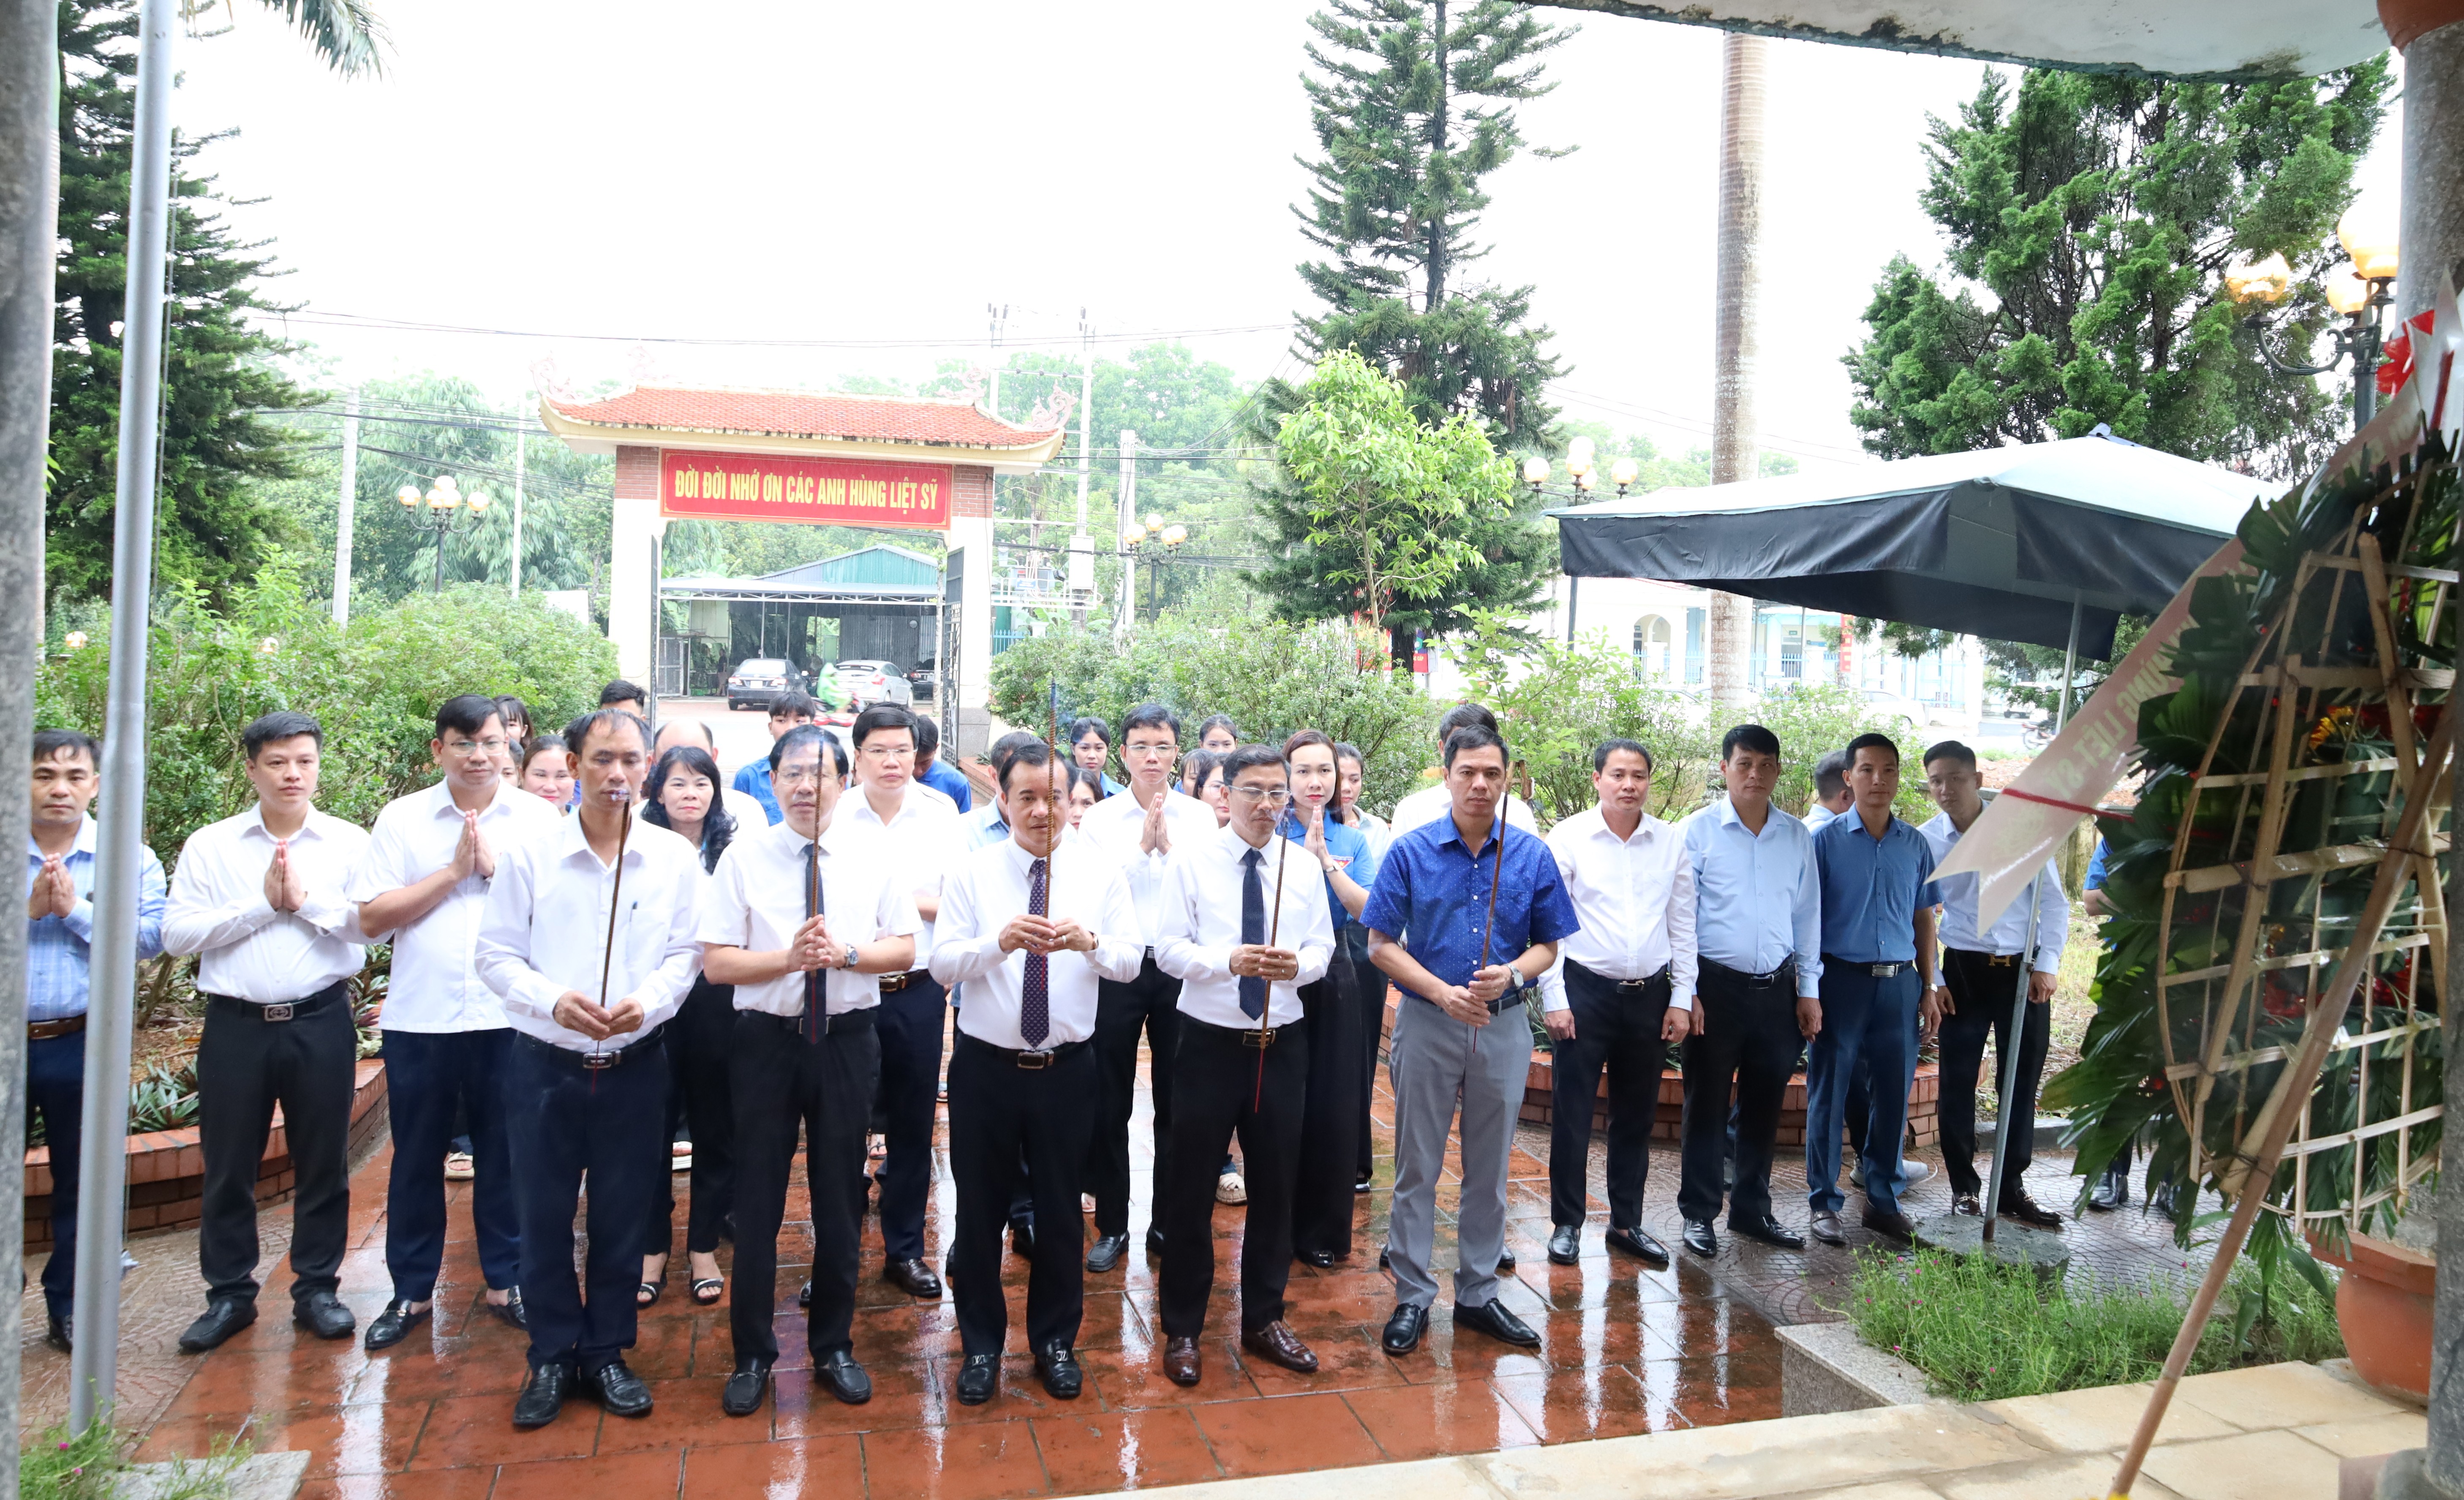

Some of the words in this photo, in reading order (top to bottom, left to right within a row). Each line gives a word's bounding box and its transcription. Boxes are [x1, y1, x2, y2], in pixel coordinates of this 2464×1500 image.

[675, 464, 699, 498] ĐỜI
[703, 466, 726, 499] ĐỜI
[730, 469, 760, 501] NHỚ
[763, 472, 782, 502] ƠN
[787, 471, 814, 503] CÁC
[817, 478, 846, 505] ANH
[849, 474, 886, 507] HÙNG
[890, 476, 917, 514] LIỆT
[920, 478, 938, 510] SỸ
